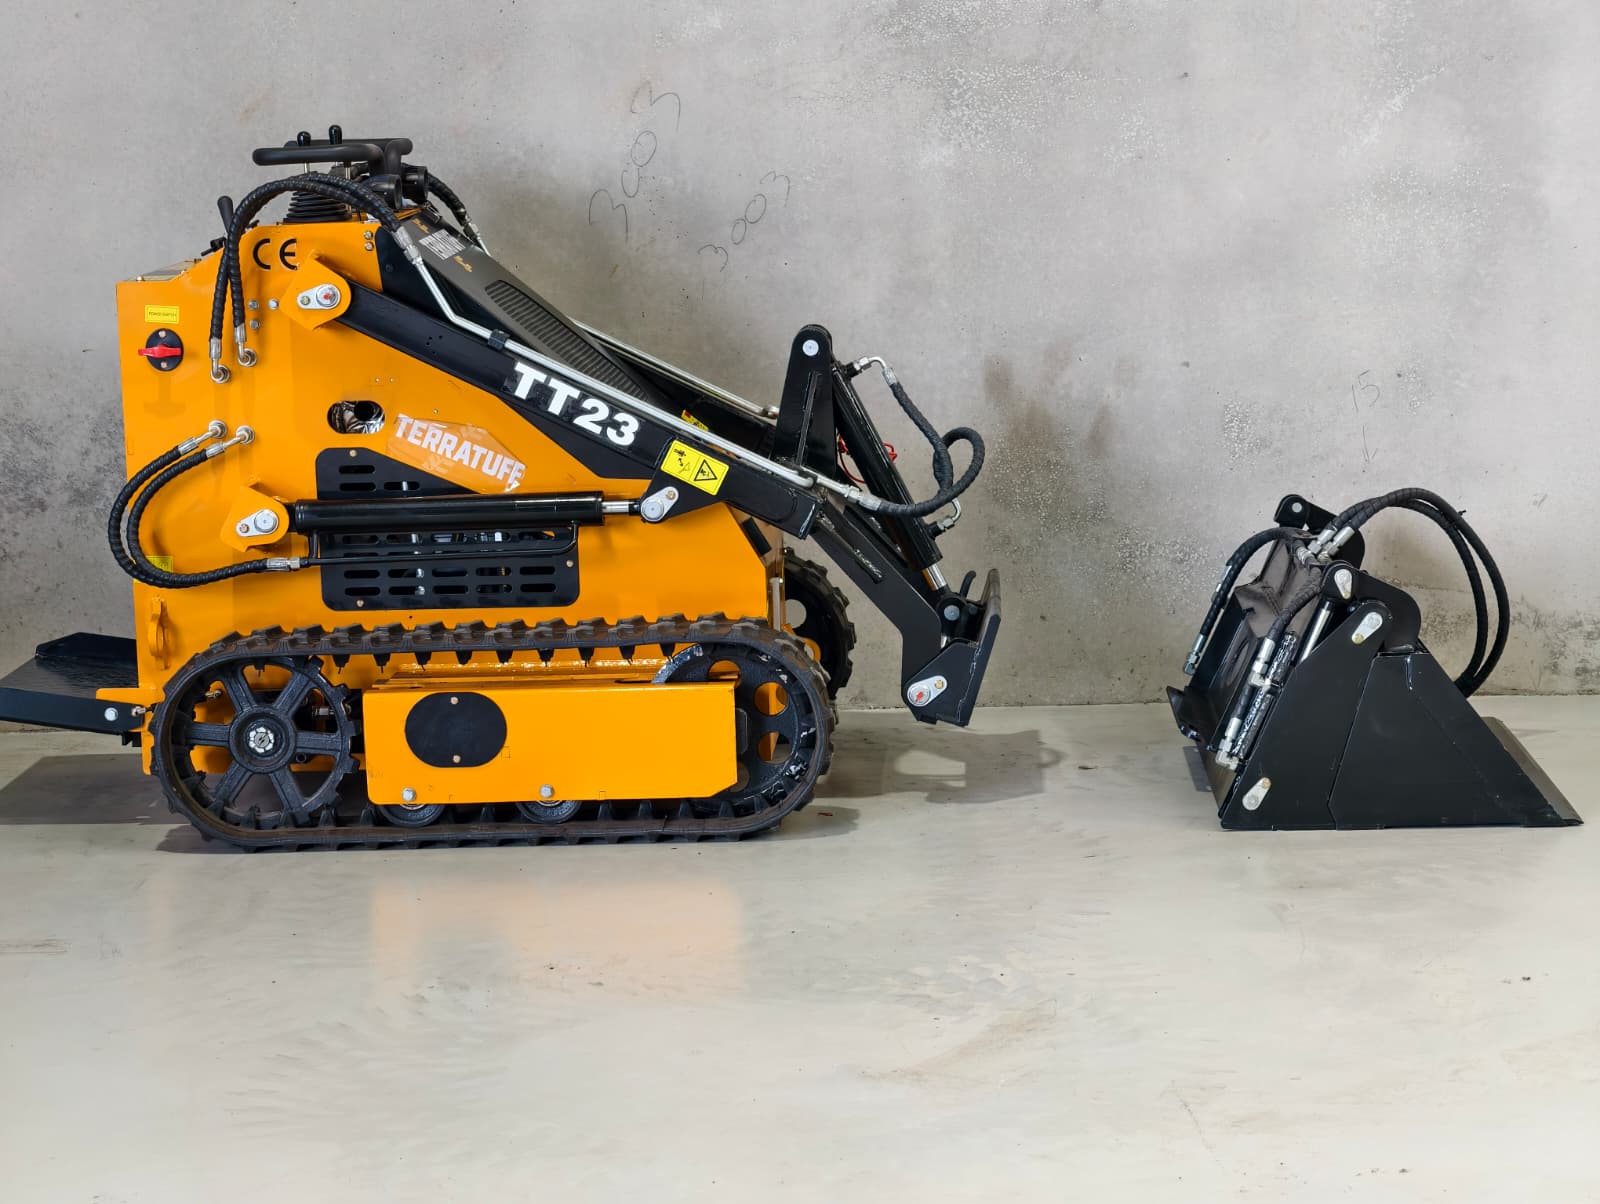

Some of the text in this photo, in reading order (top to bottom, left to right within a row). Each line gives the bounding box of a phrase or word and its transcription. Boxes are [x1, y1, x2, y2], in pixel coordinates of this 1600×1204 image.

[253, 238, 298, 270] CE
[697, 170, 791, 272] 3003
[514, 361, 640, 446] TT23
[395, 413, 526, 486] TERRATUFF
